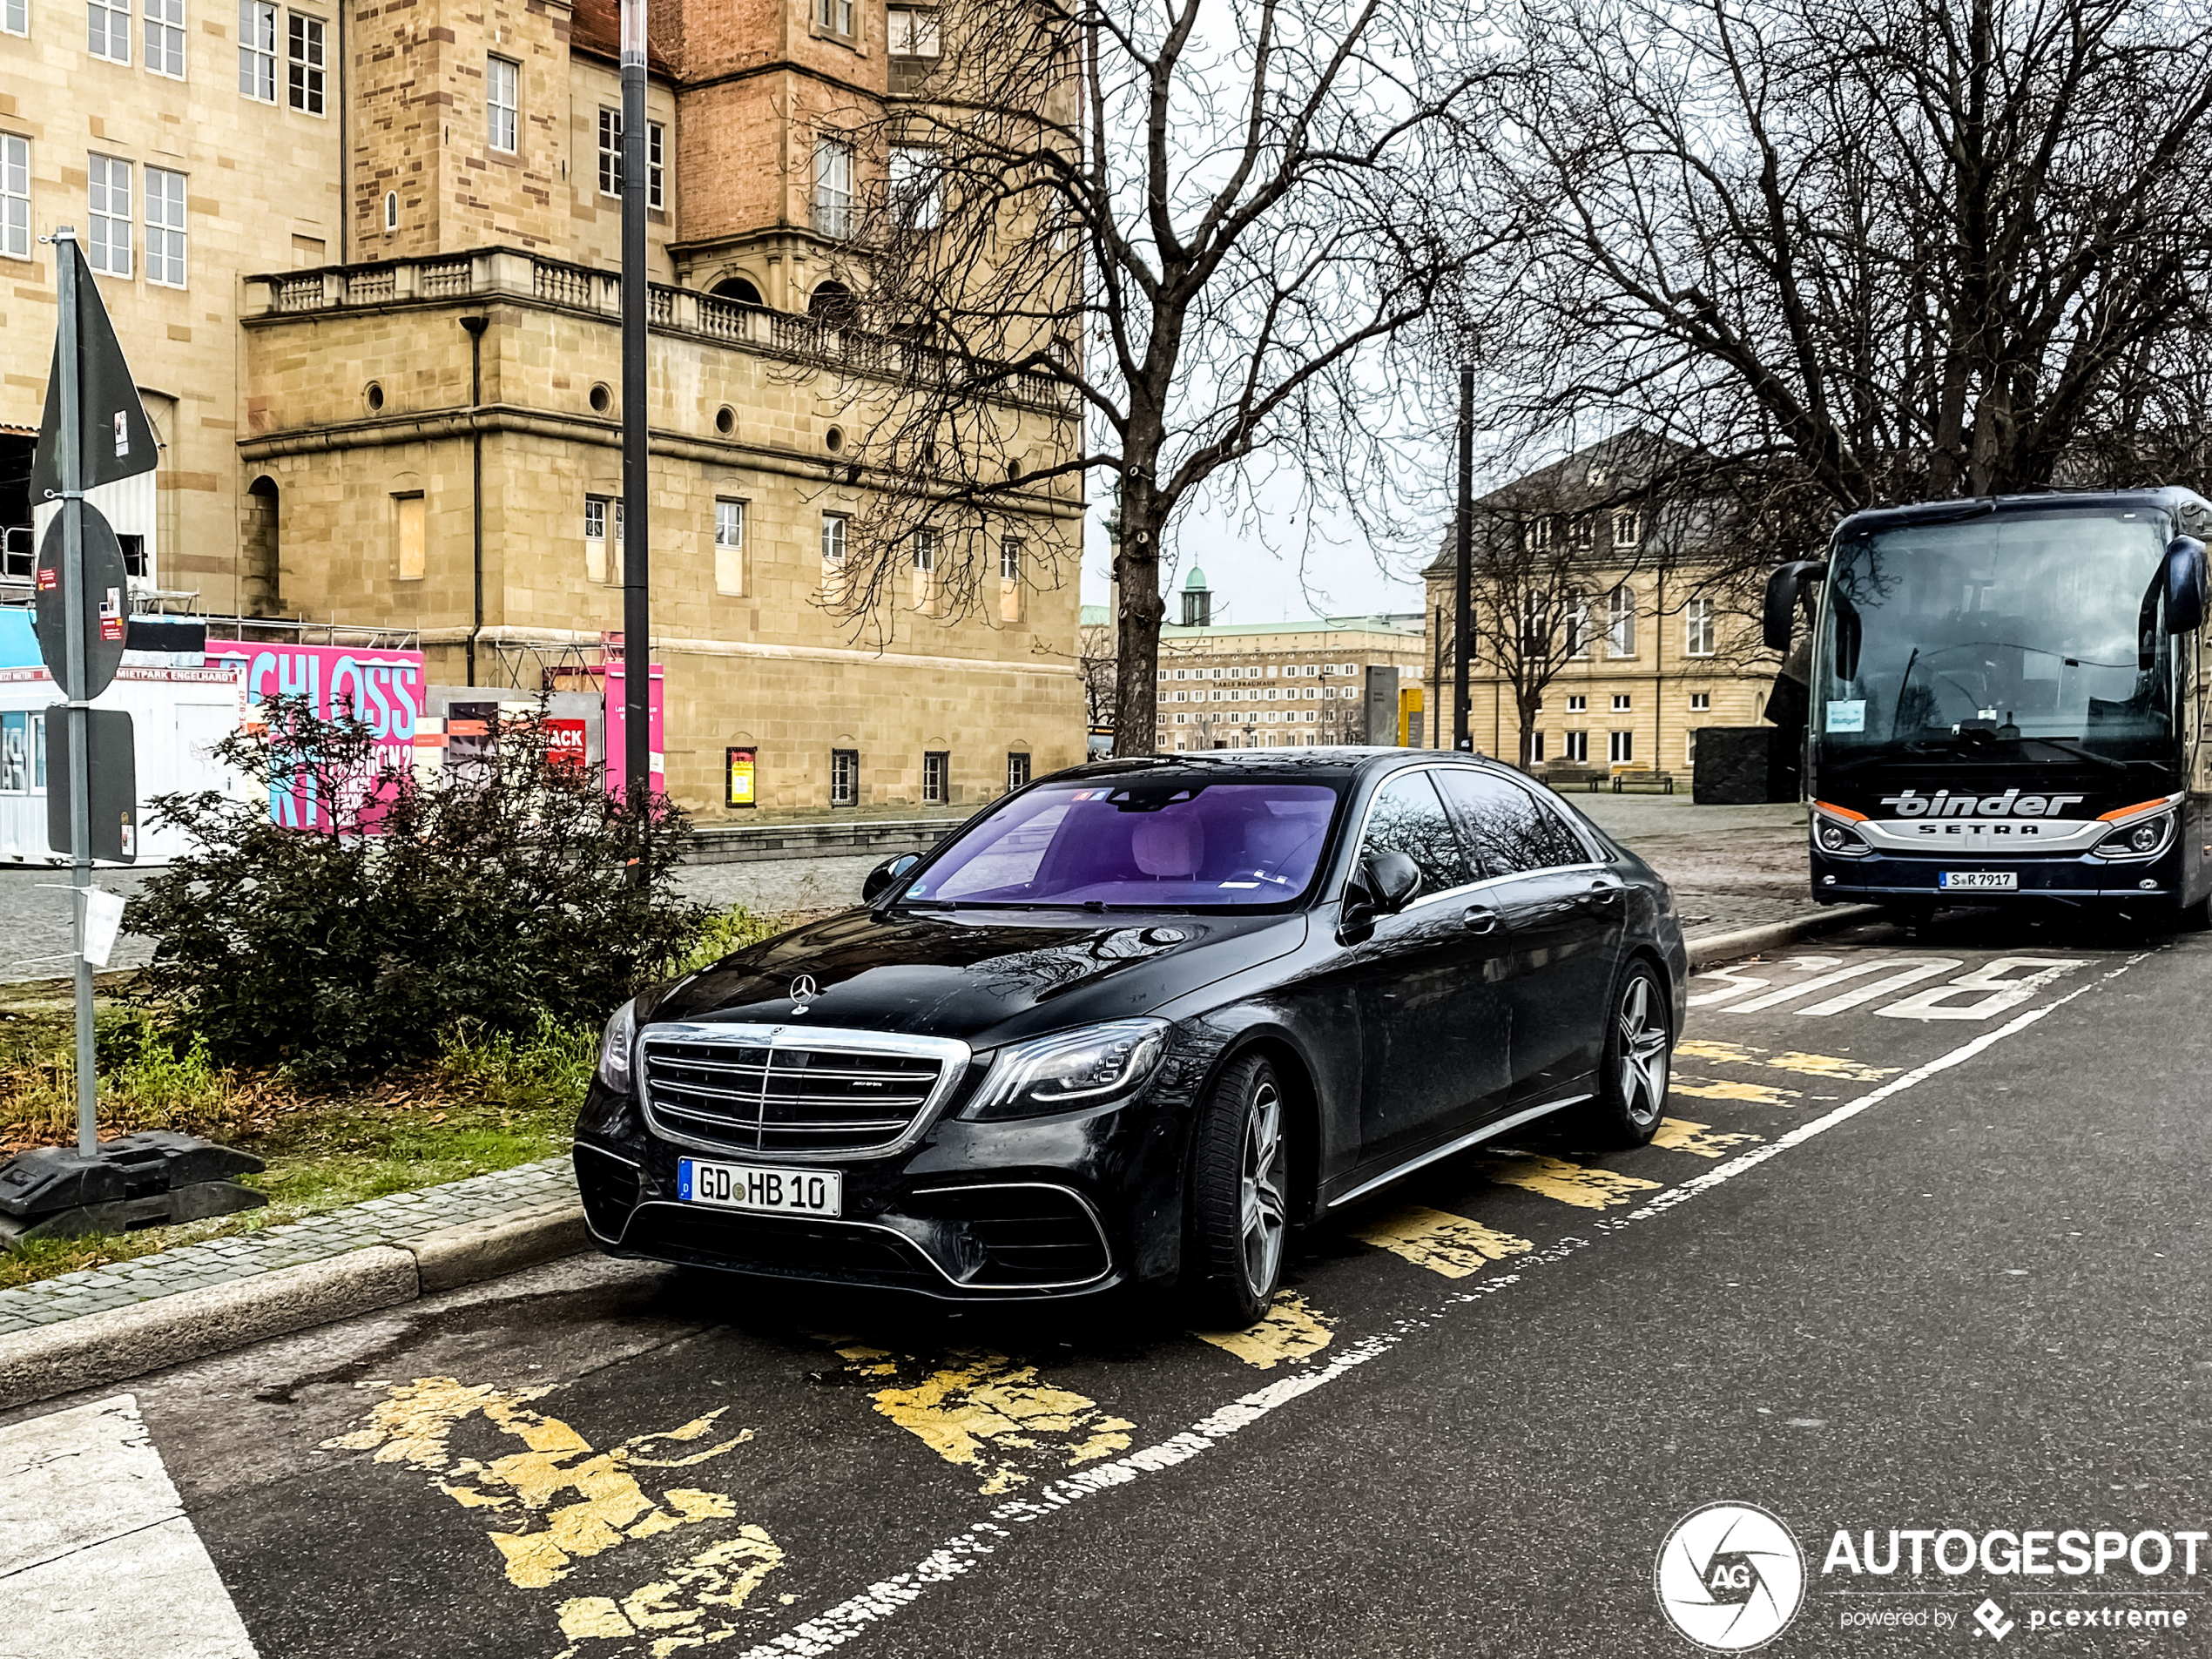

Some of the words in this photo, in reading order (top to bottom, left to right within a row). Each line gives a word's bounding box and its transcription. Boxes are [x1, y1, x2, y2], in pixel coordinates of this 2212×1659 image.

[116, 670, 168, 679] MIETPARK
[170, 671, 233, 682] ENGELHARDT
[219, 651, 416, 739] CHLOSS
[1880, 788, 2084, 816] binder
[1919, 825, 2039, 834] SETRA
[1952, 874, 1960, 886] S
[1979, 873, 2011, 886] 7917
[700, 1166, 731, 1201] GD
[748, 1171, 783, 1205] HB
[790, 1176, 825, 1209] 10
